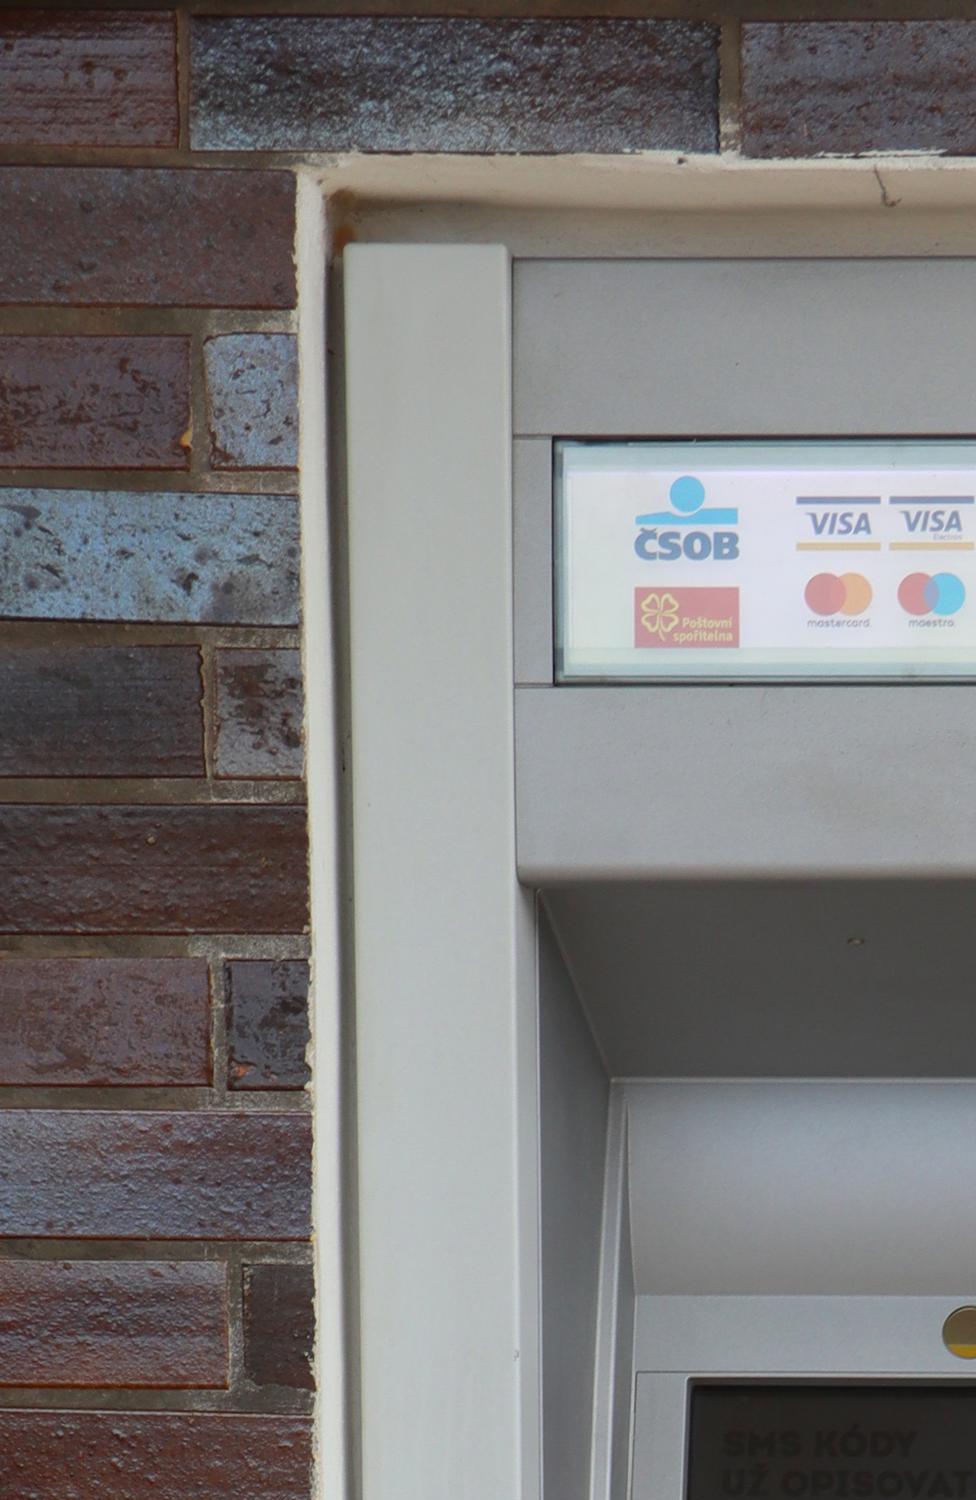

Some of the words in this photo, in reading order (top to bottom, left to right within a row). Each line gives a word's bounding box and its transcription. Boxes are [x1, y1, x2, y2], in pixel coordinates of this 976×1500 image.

[805, 512, 872, 536] VISA
[899, 509, 963, 533] VISA
[634, 527, 740, 561] ČSOB
[682, 615, 733, 630] Poštovní
[807, 616, 871, 628] mastercard
[908, 617, 955, 628] maestro
[672, 629, 734, 645] spořitelna
[721, 1430, 802, 1458] SMS
[813, 1422, 920, 1458] KÓDY
[720, 1463, 769, 1497] UŽ
[779, 1468, 974, 1498] OPISOVAT
